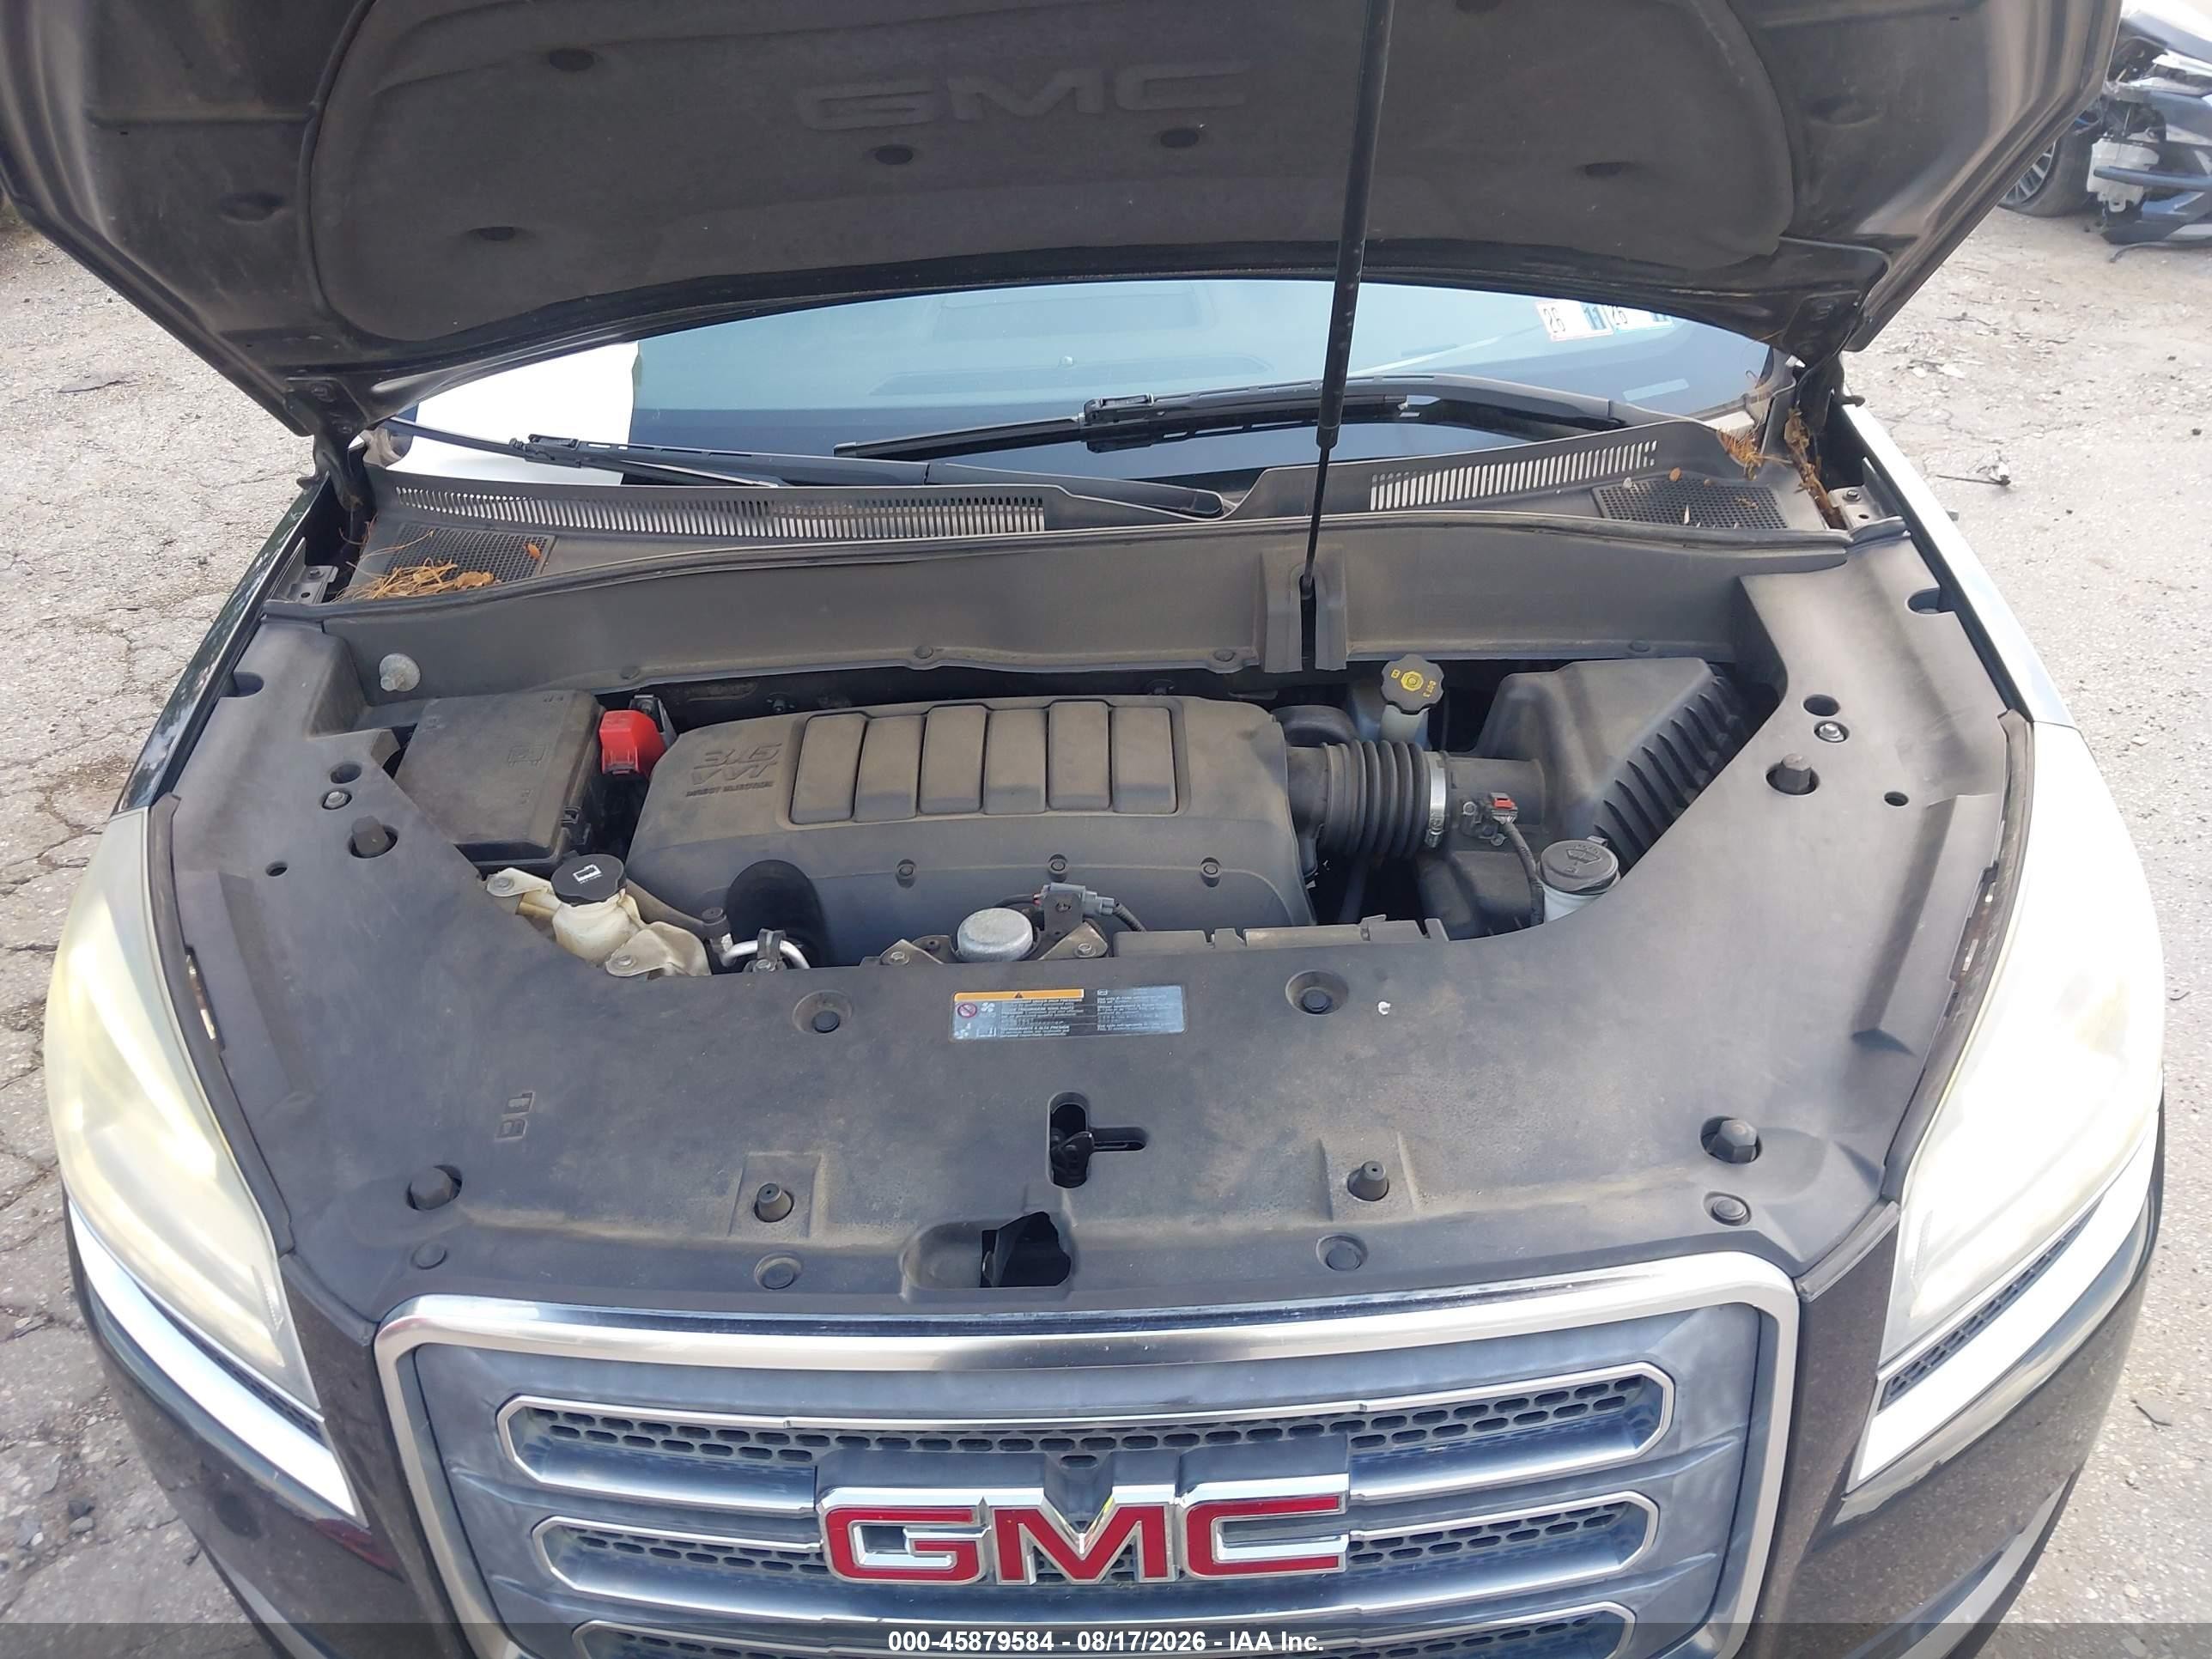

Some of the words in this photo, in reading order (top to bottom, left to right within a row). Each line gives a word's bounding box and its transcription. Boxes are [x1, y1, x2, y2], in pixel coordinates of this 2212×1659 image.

[795, 59, 1251, 131] GMC
[1543, 307, 1566, 333] 26
[1583, 307, 1607, 331] 11
[690, 761, 778, 786] VVT
[817, 1474, 1349, 1585] GMC
